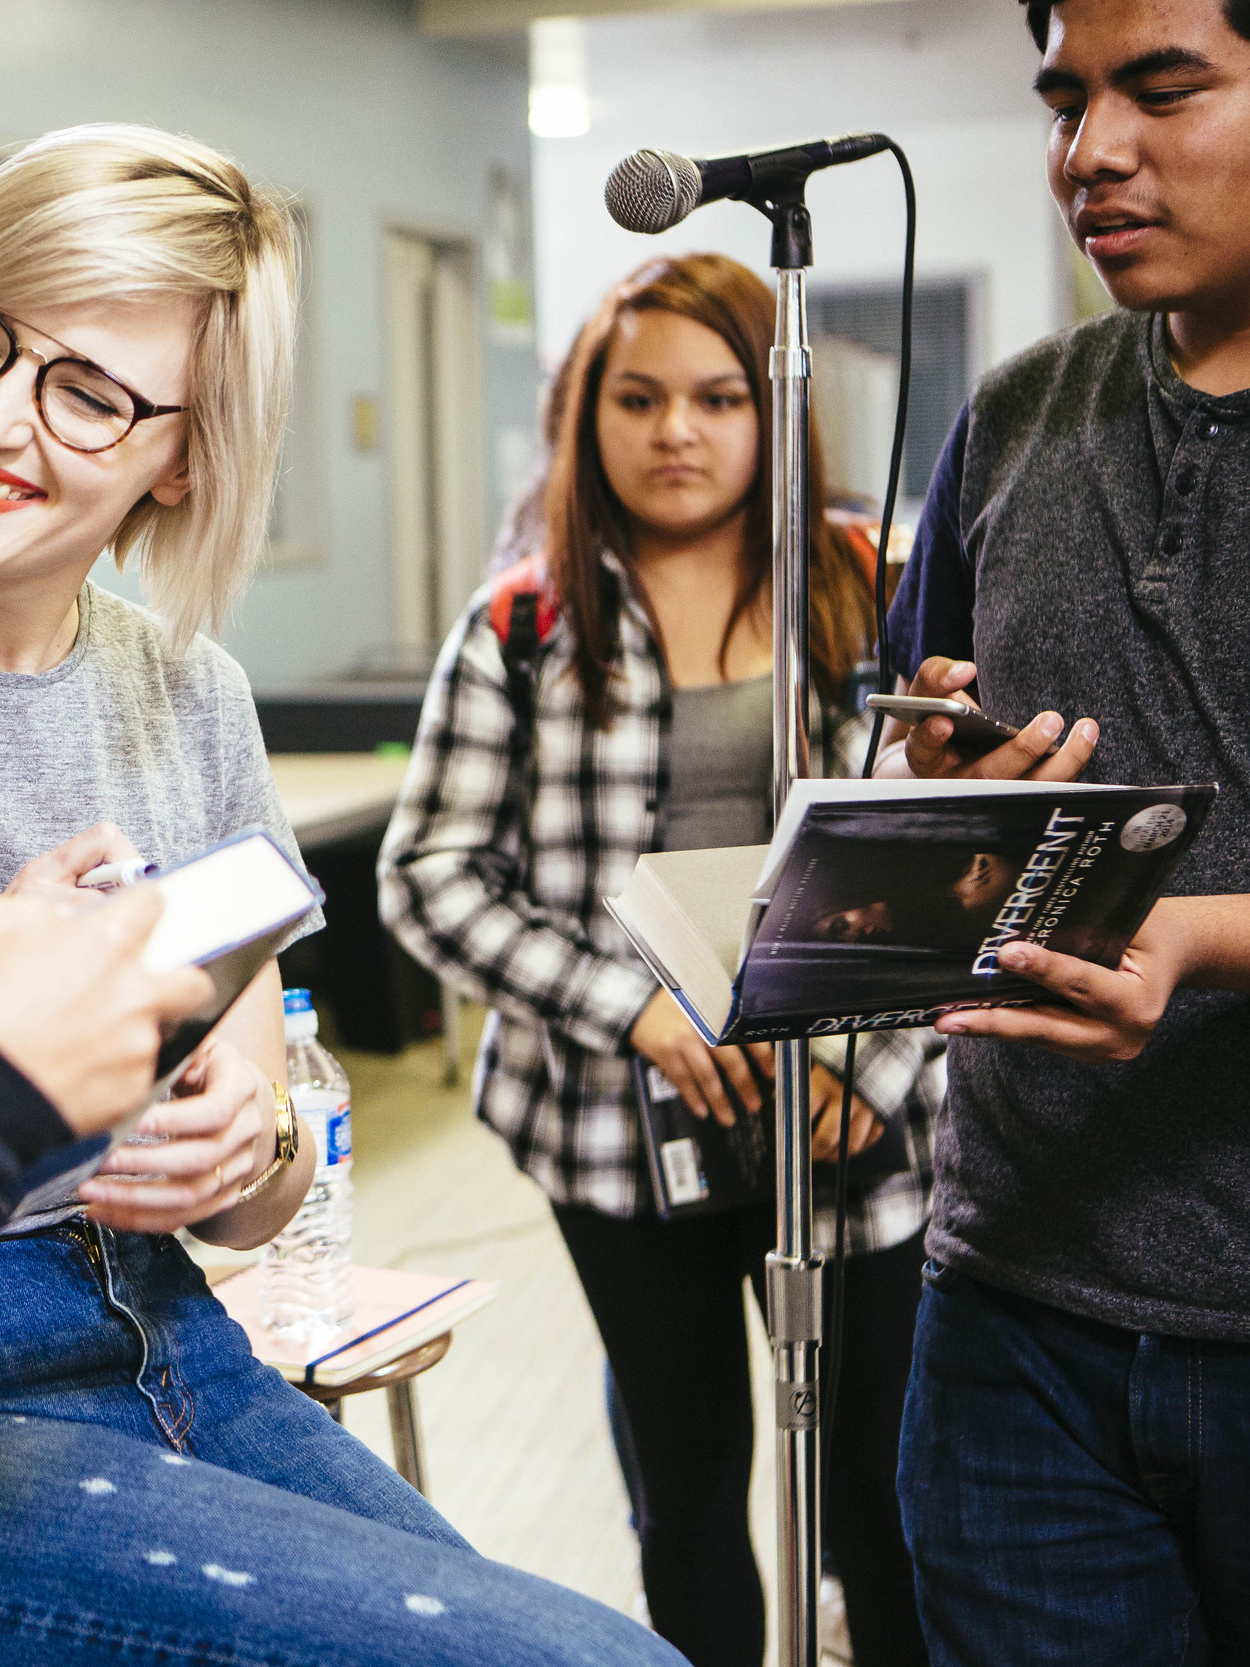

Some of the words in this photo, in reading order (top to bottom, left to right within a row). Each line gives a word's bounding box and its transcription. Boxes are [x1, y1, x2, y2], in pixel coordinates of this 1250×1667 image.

[1033, 916, 1045, 930] YORK
[1042, 896, 1058, 914] TIMES
[1053, 857, 1081, 896] BESTSELLING
[1076, 830, 1095, 855] AUTHOR
[1033, 877, 1085, 949] ERONICA
[1079, 821, 1116, 868] ROTH
[744, 1026, 790, 1037] ROTH
